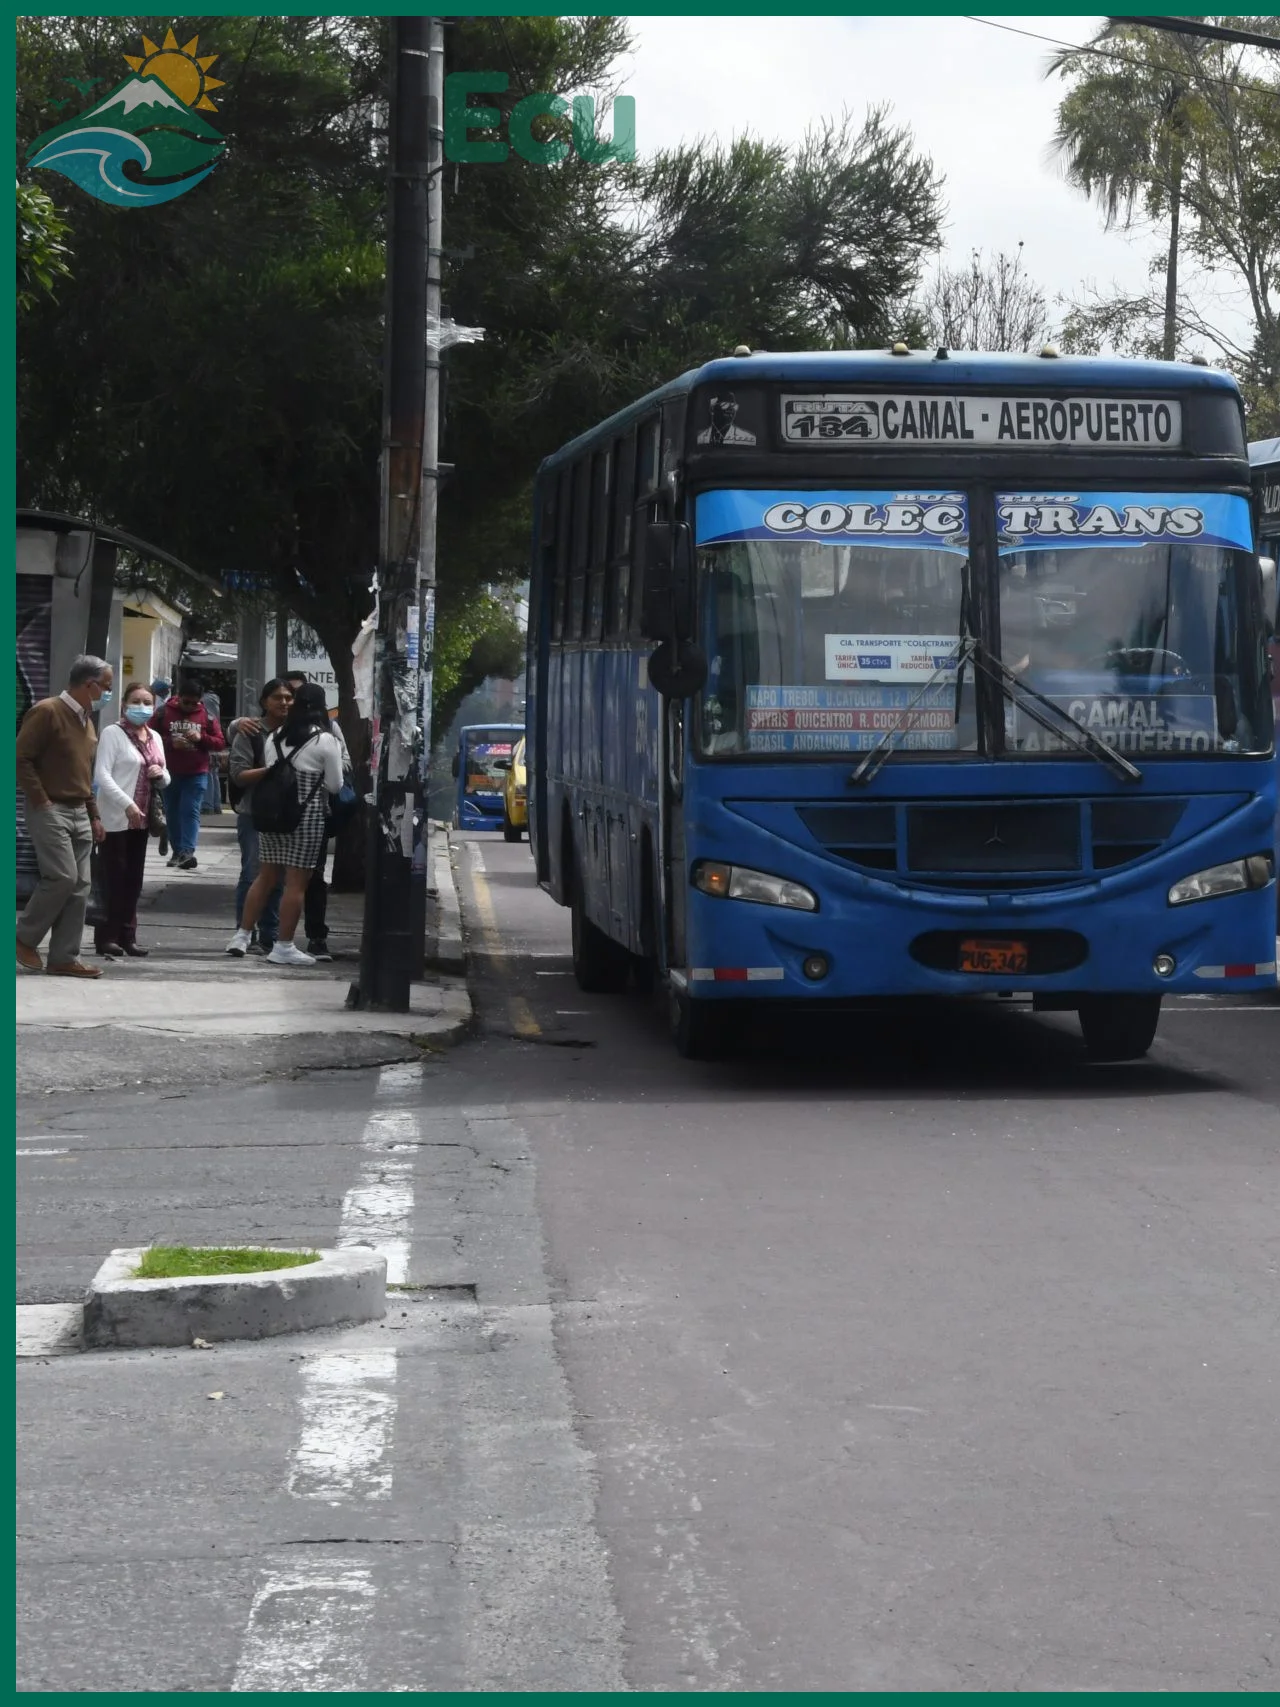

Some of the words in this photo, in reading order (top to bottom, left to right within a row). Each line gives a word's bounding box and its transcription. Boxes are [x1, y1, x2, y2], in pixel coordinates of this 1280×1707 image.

[792, 401, 876, 414] RUTA
[791, 415, 873, 438] 134
[882, 400, 975, 440] CAMAL
[998, 402, 1172, 443] AEROPUERTO
[764, 502, 965, 535] COLEC
[999, 505, 1205, 537] TRANS
[751, 690, 777, 705] NAPO
[783, 690, 820, 706] TREBOL
[751, 712, 788, 728] SHYRIS
[794, 712, 853, 728] QUICENTRO
[1068, 700, 1164, 727] CAMAL
[750, 734, 787, 750] BRASIL
[793, 734, 850, 750] ANDALUCIA
